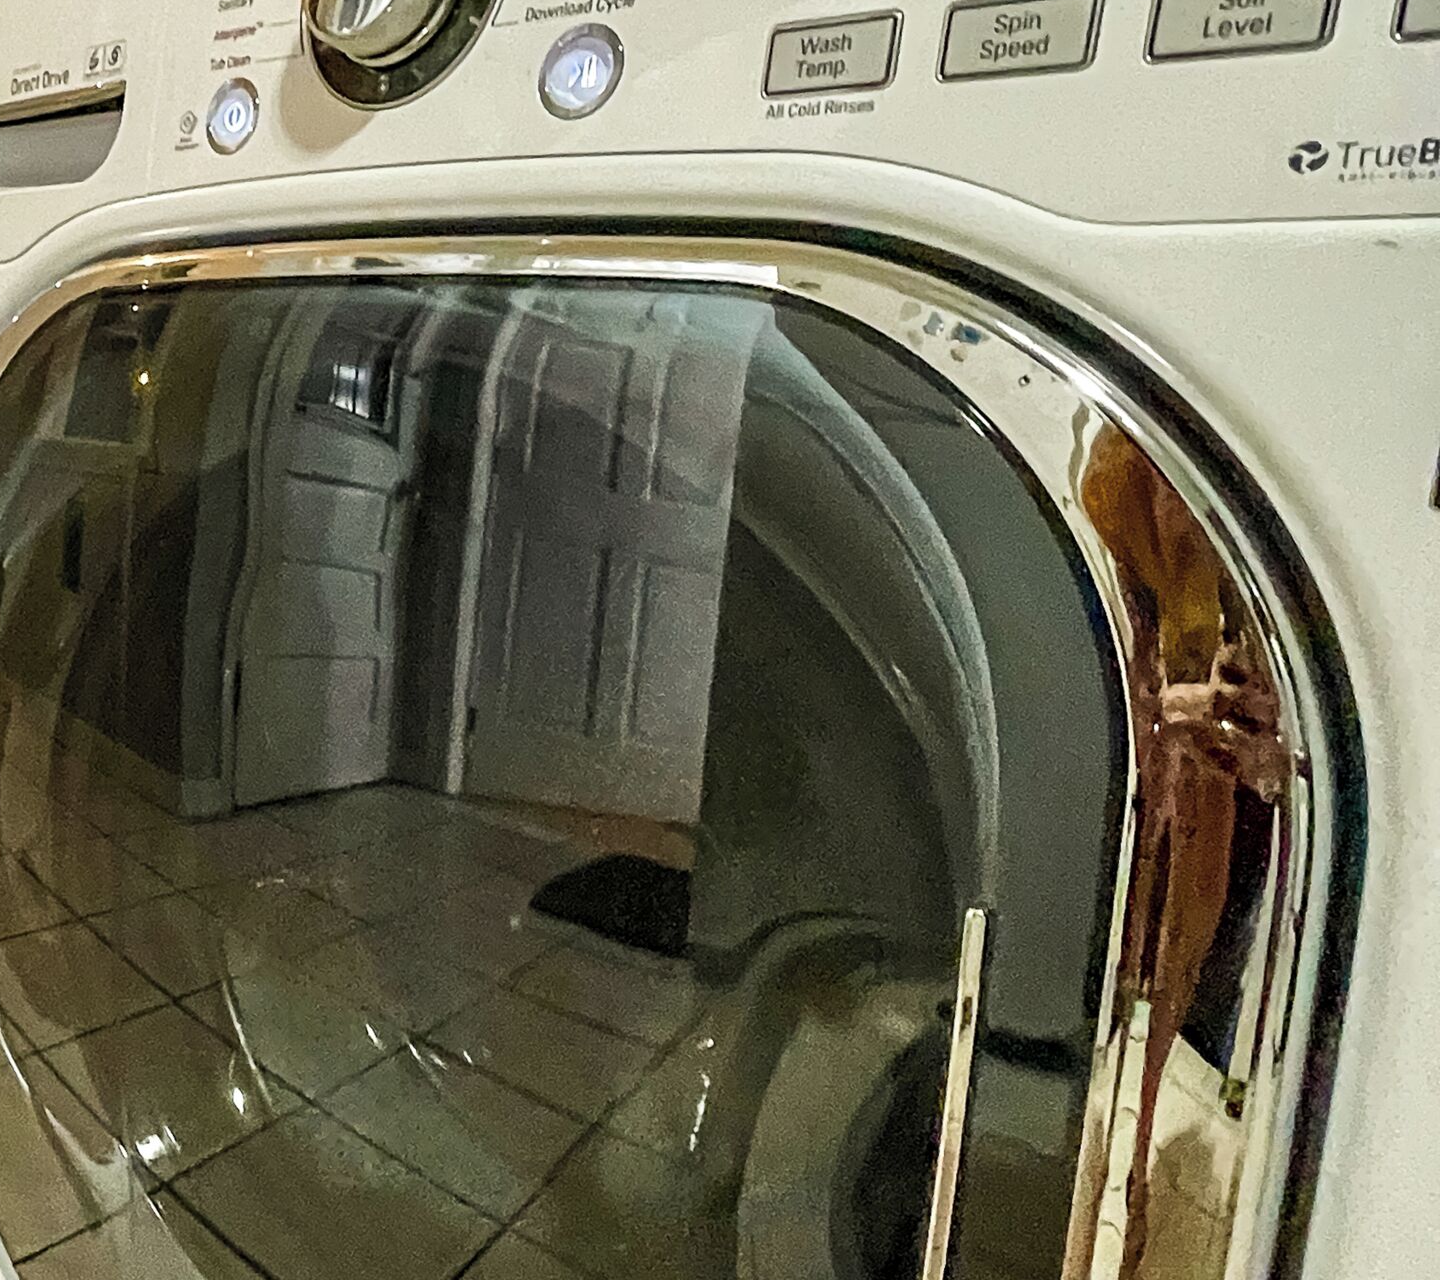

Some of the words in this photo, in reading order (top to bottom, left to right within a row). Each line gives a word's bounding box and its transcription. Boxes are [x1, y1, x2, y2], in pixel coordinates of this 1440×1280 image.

[993, 11, 1042, 37] Spin
[1202, 12, 1273, 40] Level
[800, 32, 853, 56] Wash
[979, 34, 1050, 62] Speed
[11, 73, 40, 95] Direct
[42, 69, 70, 89] Drive
[765, 103, 784, 119] All
[787, 101, 820, 118] Cold
